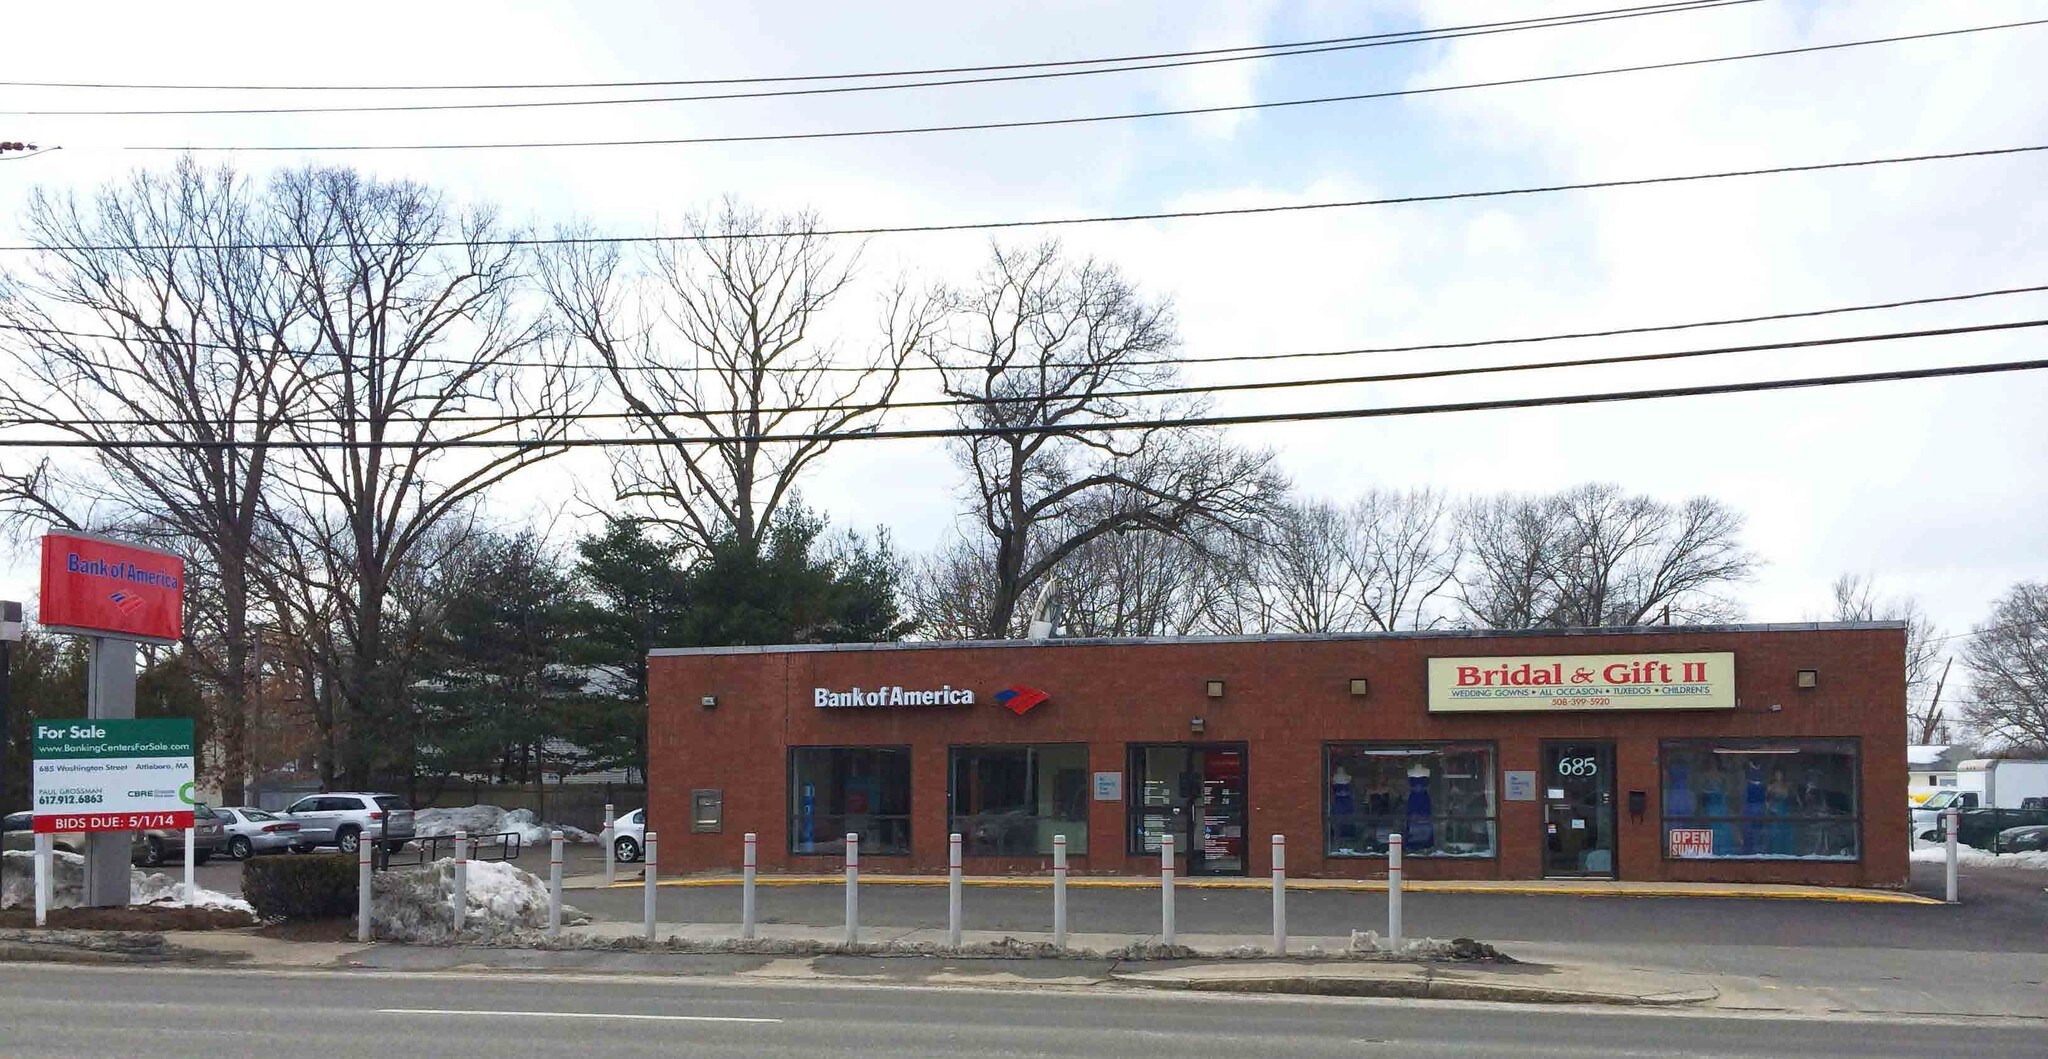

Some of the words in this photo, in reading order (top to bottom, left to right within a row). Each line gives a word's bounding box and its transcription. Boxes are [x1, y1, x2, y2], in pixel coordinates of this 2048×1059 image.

[68, 553, 108, 577] Bank
[110, 562, 125, 579] of
[127, 564, 178, 589] America
[1456, 663, 1563, 686] Bridal
[1570, 667, 1595, 684] &
[1603, 661, 1673, 684] Gift
[1682, 662, 1707, 683] II
[814, 687, 866, 707] Bank
[866, 686, 889, 706] of
[889, 685, 975, 706] America
[1452, 689, 1492, 697] WEDDING
[1495, 688, 1529, 696] GOWNS
[1540, 688, 1553, 696] ALL
[1556, 687, 1603, 696] OCCASION
[1613, 687, 1651, 695] TUXEDOS
[1661, 686, 1710, 694] CHILDREN'S
[1551, 698, 1610, 706] 508-399-5920
[38, 726, 65, 739] For
[69, 724, 106, 739] Sale
[39, 742, 189, 753] www.BankingCentersForSale.com
[57, 764, 104, 773] Washington
[176, 762, 189, 770] MA
[1558, 757, 1597, 777] 685
[59, 787, 103, 795] GROSSMAN
[127, 790, 153, 798] CBRE
[39, 795, 103, 805] 617.912.6863
[55, 818, 86, 829] BIDS
[91, 816, 124, 828] DUE:
[129, 814, 174, 827] 5/1/14
[1672, 831, 1710, 844] OPEN
